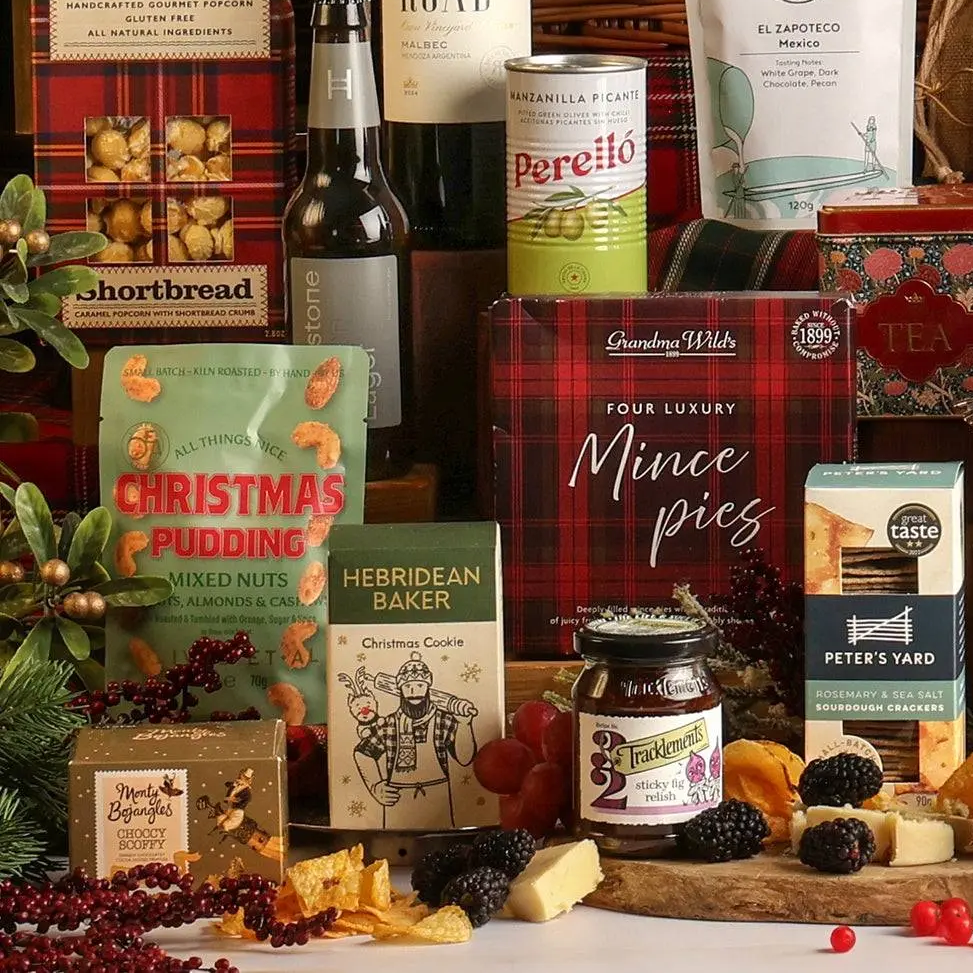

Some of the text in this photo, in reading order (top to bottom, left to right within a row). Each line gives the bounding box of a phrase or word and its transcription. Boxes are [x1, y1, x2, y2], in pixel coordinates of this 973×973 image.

[66, 0, 254, 10] HANDCRAFTED GOURMET POPCORN
[125, 14, 195, 23] GLUTEN FREE
[87, 28, 233, 37] ALL NATURAL INGREDIENTS
[758, 23, 841, 34] EL ZAPOTECO
[401, 41, 448, 49] MALBEC
[778, 38, 820, 49] Mexico
[761, 68, 839, 79] White Grape, Dark
[763, 79, 838, 89] Chocolate, Pecan
[510, 89, 640, 104] MANZANILLA PICANTE
[515, 129, 636, 188] Perelló
[788, 200, 815, 212] 120g
[74, 311, 111, 319] CARAMEL
[113, 310, 151, 318] POPCORN
[175, 309, 228, 317] SHORTBREAD
[229, 309, 256, 317] CRUMB
[304, 269, 321, 345] stone
[791, 310, 841, 336] BAKED WITHOUT
[605, 330, 737, 351] Grandma Wild's
[800, 328, 832, 344] 1899
[877, 322, 952, 352] TEA
[793, 341, 840, 360] COMPROMISE
[156, 367, 186, 377] BATCH
[193, 368, 216, 376] KILN
[217, 367, 262, 377] ROASTED
[269, 369, 282, 377] BY
[285, 369, 310, 378] HAND
[607, 403, 736, 415] FOUR LUXURY
[174, 434, 288, 462] ALL THINGS NICE
[568, 423, 750, 502] Mince
[115, 473, 346, 516] CHRISTMAS
[901, 514, 927, 525] great
[650, 491, 777, 569] pies
[890, 524, 940, 539] taste
[150, 527, 306, 560] PUDDING
[168, 572, 289, 588] MIXED NUTS
[343, 566, 481, 588] HEBRIDEAN
[186, 596, 253, 607] ALMONDS
[256, 596, 266, 607] &
[373, 591, 451, 611] BAKER
[361, 636, 464, 649] Christmas Cookie
[824, 651, 936, 665] PETER'S YARD
[815, 690, 944, 699] ROSEMARY & SEA SALT
[815, 704, 945, 712] SOURDOUGH CRACKERS
[613, 723, 705, 770] Tracklements
[635, 778, 685, 791] sticky fig
[115, 782, 159, 806] Monty
[645, 788, 676, 802] relish
[107, 799, 173, 824] Bojangles
[117, 828, 167, 839] CHOCCY
[118, 839, 166, 851] SCOFFY
